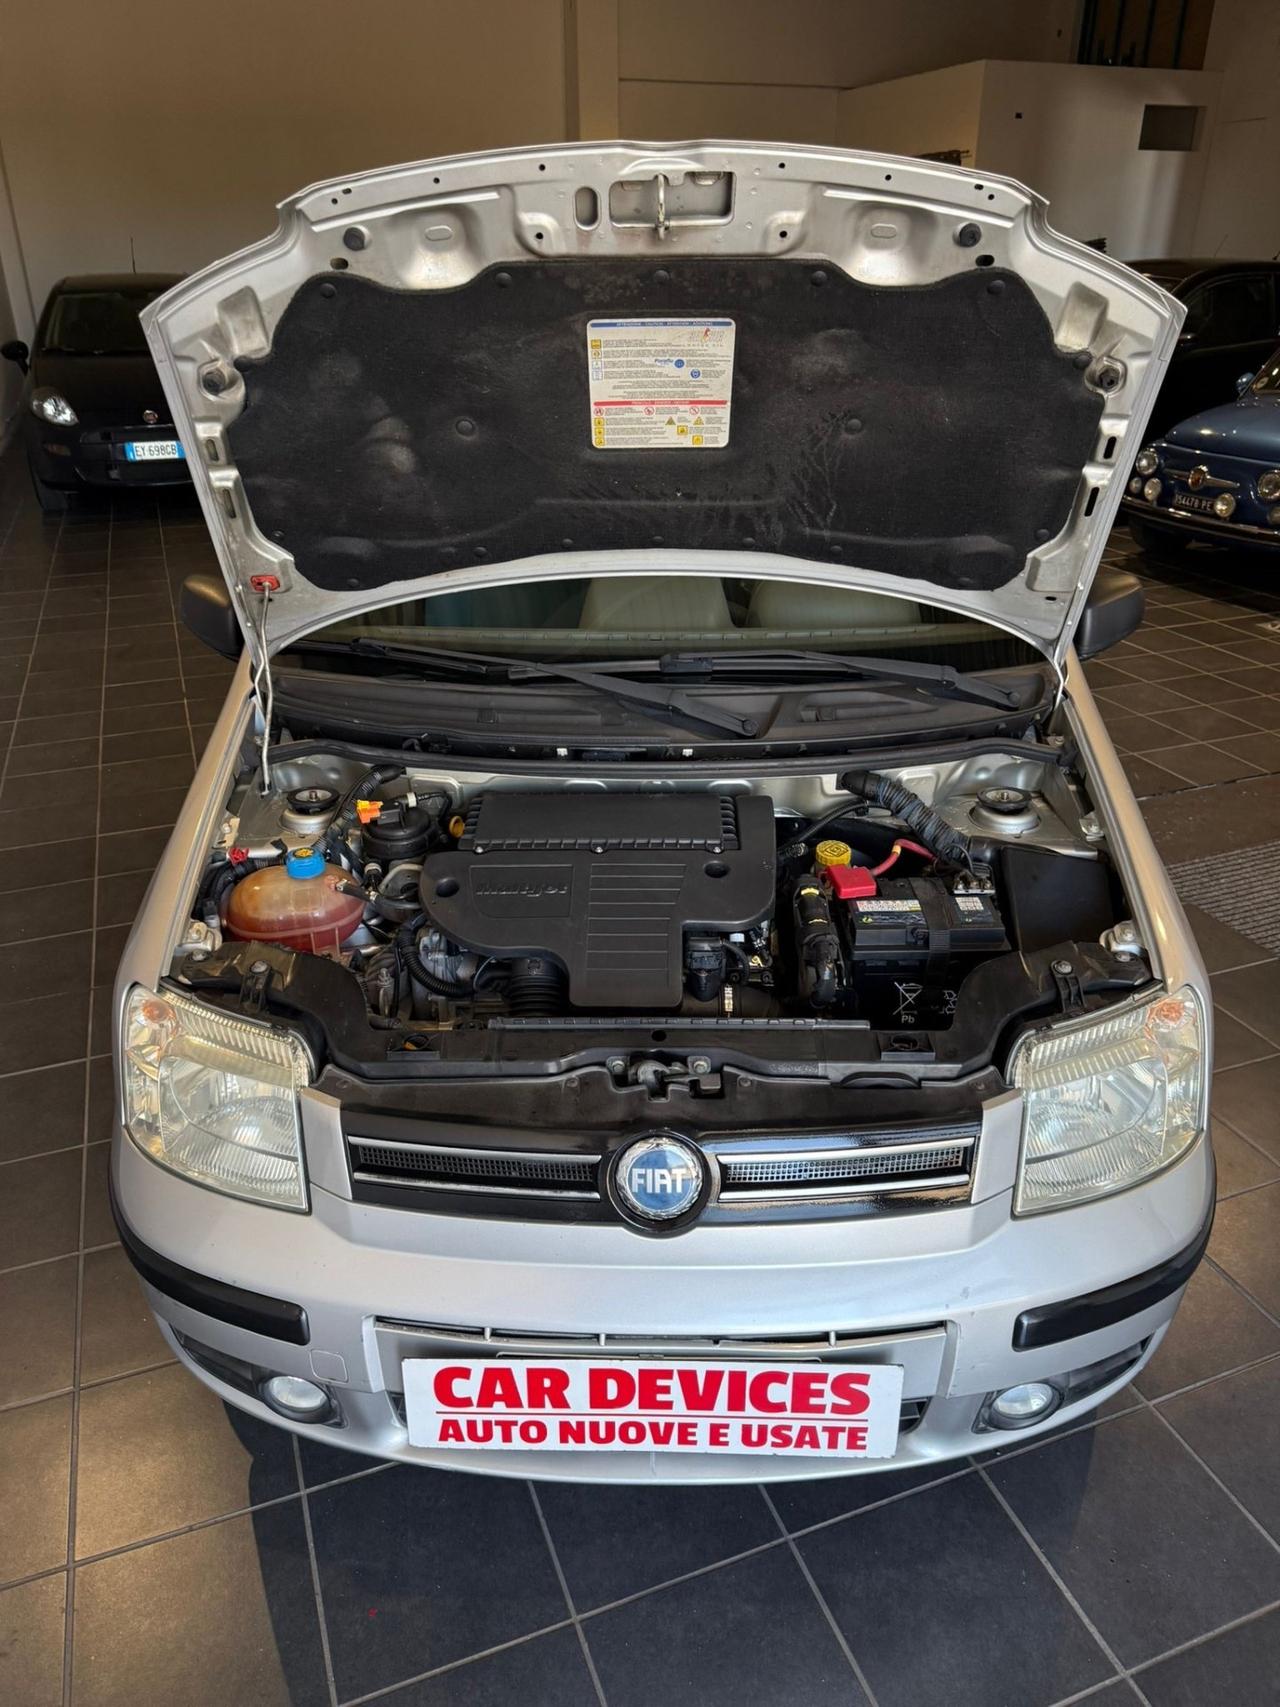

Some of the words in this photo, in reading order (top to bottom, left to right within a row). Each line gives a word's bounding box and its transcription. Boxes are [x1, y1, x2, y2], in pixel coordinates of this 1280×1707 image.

[901, 1015, 915, 1024] Pb
[631, 1168, 687, 1194] FIAT
[433, 1366, 571, 1410] CAR
[588, 1368, 870, 1416] DEVICES
[438, 1419, 548, 1445] AUTO
[558, 1420, 698, 1447] NUOVE
[708, 1424, 730, 1447] E
[741, 1424, 867, 1451] USATE
